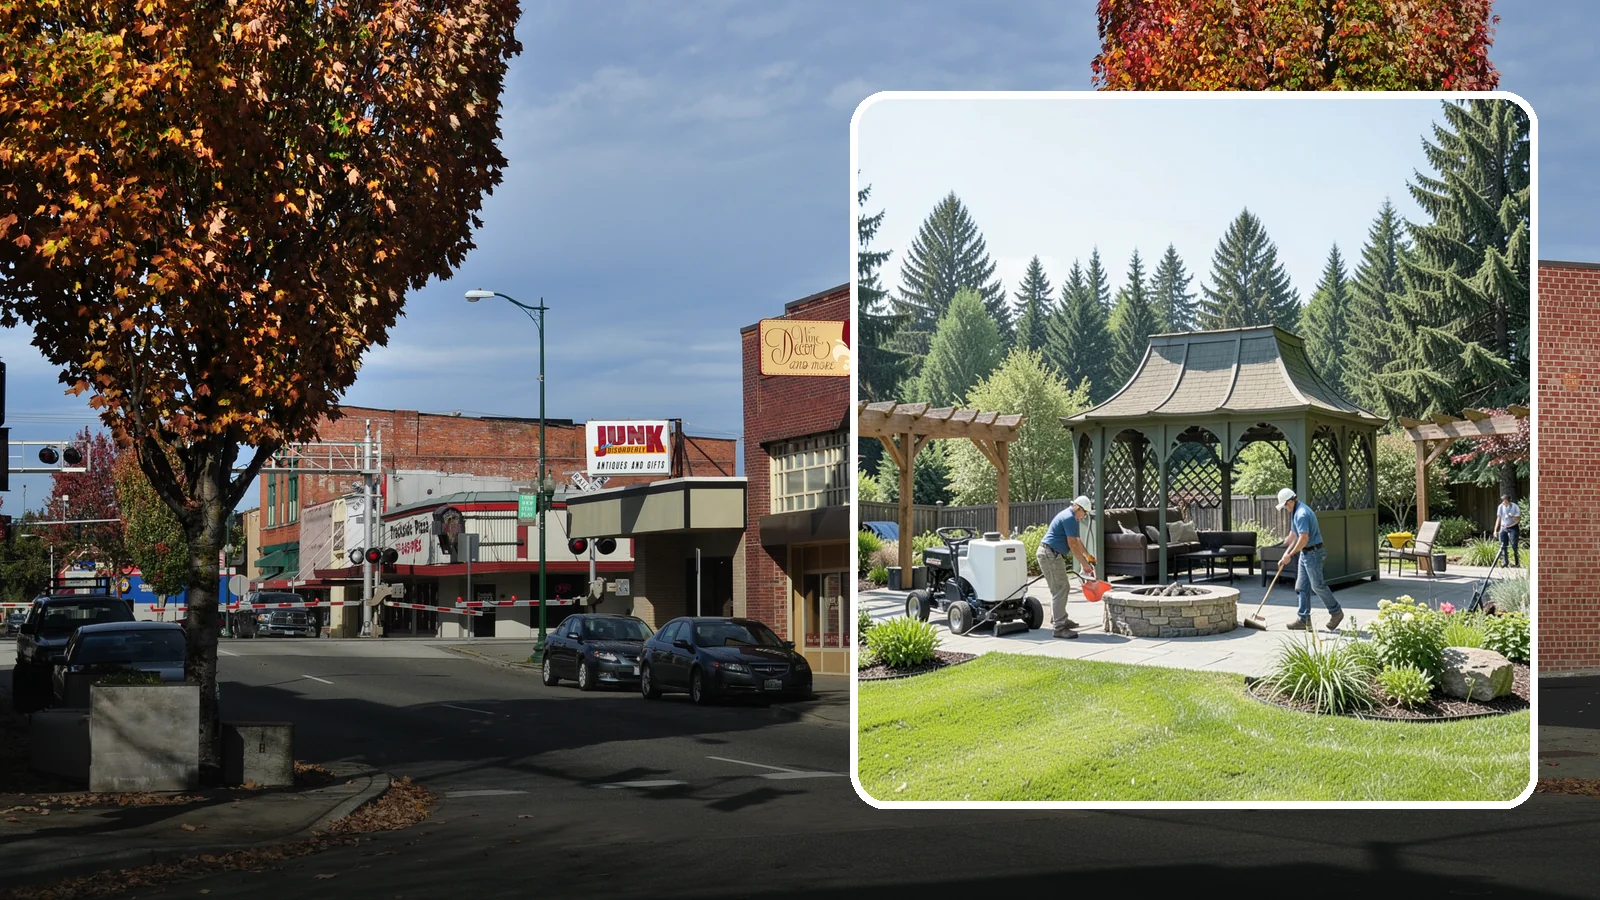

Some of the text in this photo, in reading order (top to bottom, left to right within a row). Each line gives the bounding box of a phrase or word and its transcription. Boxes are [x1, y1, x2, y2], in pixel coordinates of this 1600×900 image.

[765, 328, 830, 365] Decor
[595, 425, 665, 457] JUNK
[607, 446, 646, 454] DISORDERLY
[597, 460, 666, 470] ANTIQUES AND GIFTS
[390, 520, 429, 539] Trackside Pizza
